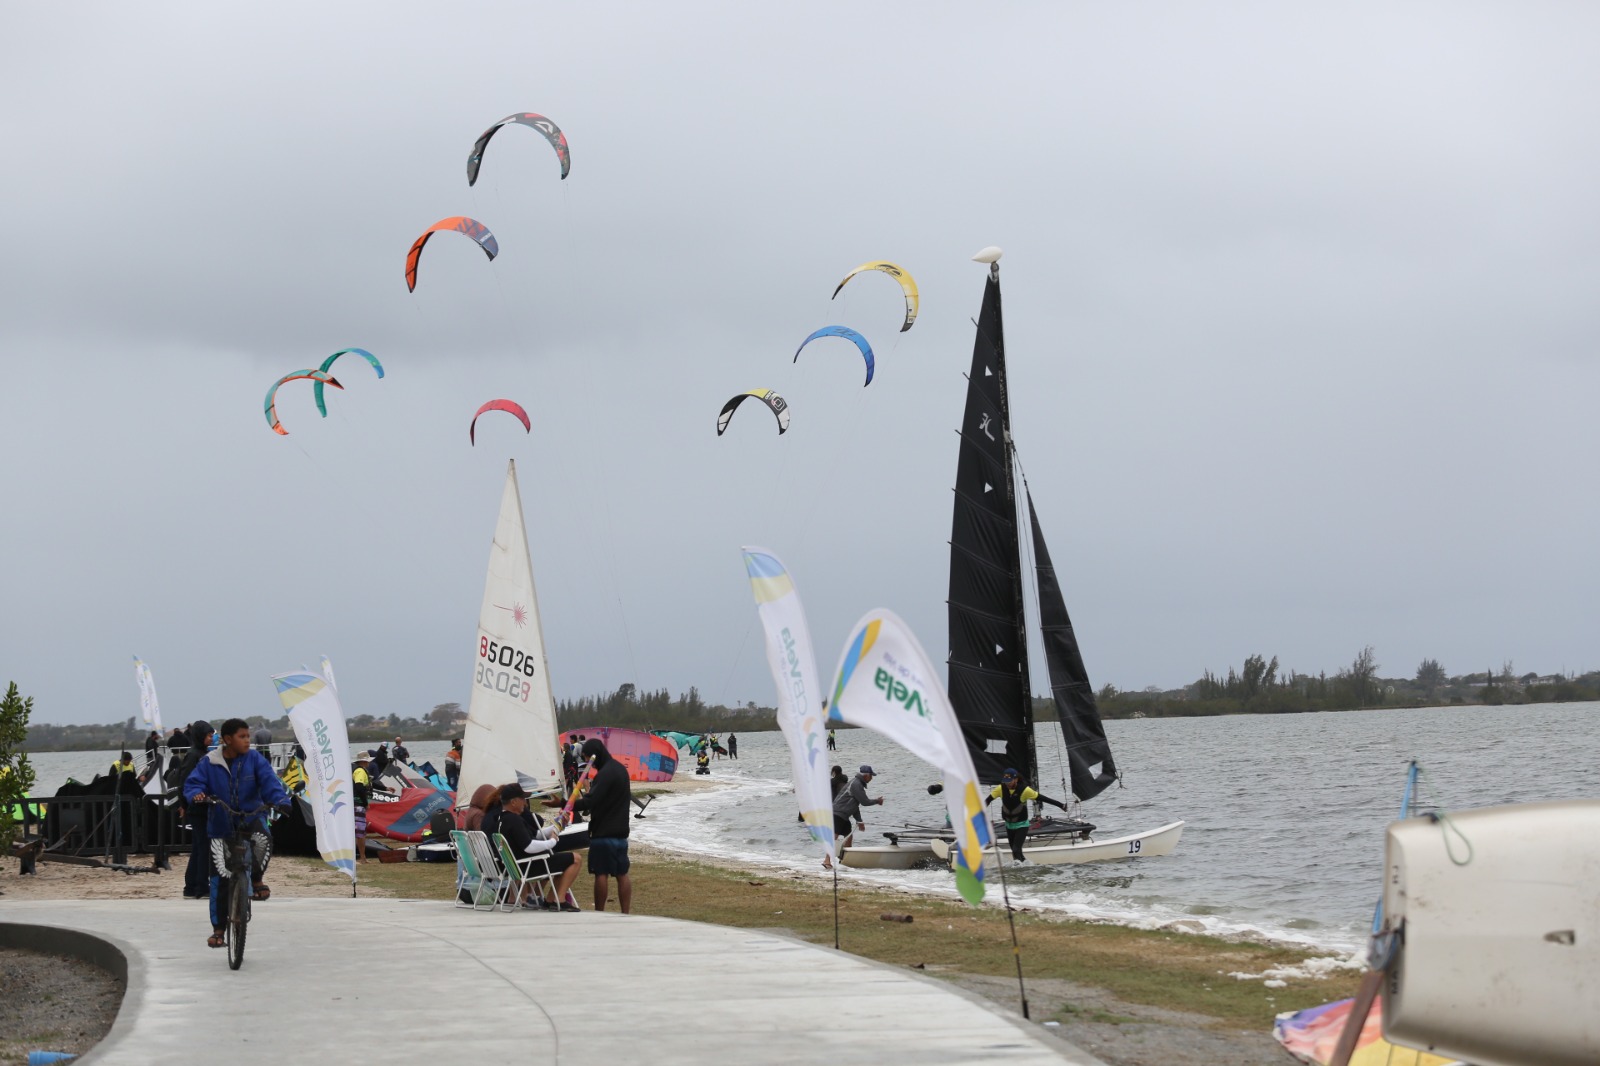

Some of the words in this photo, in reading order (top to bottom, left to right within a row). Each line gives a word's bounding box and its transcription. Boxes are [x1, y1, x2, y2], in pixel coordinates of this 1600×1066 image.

[480, 636, 534, 677] 85026
[875, 667, 932, 722] Vela
[1128, 840, 1141, 854] 19
